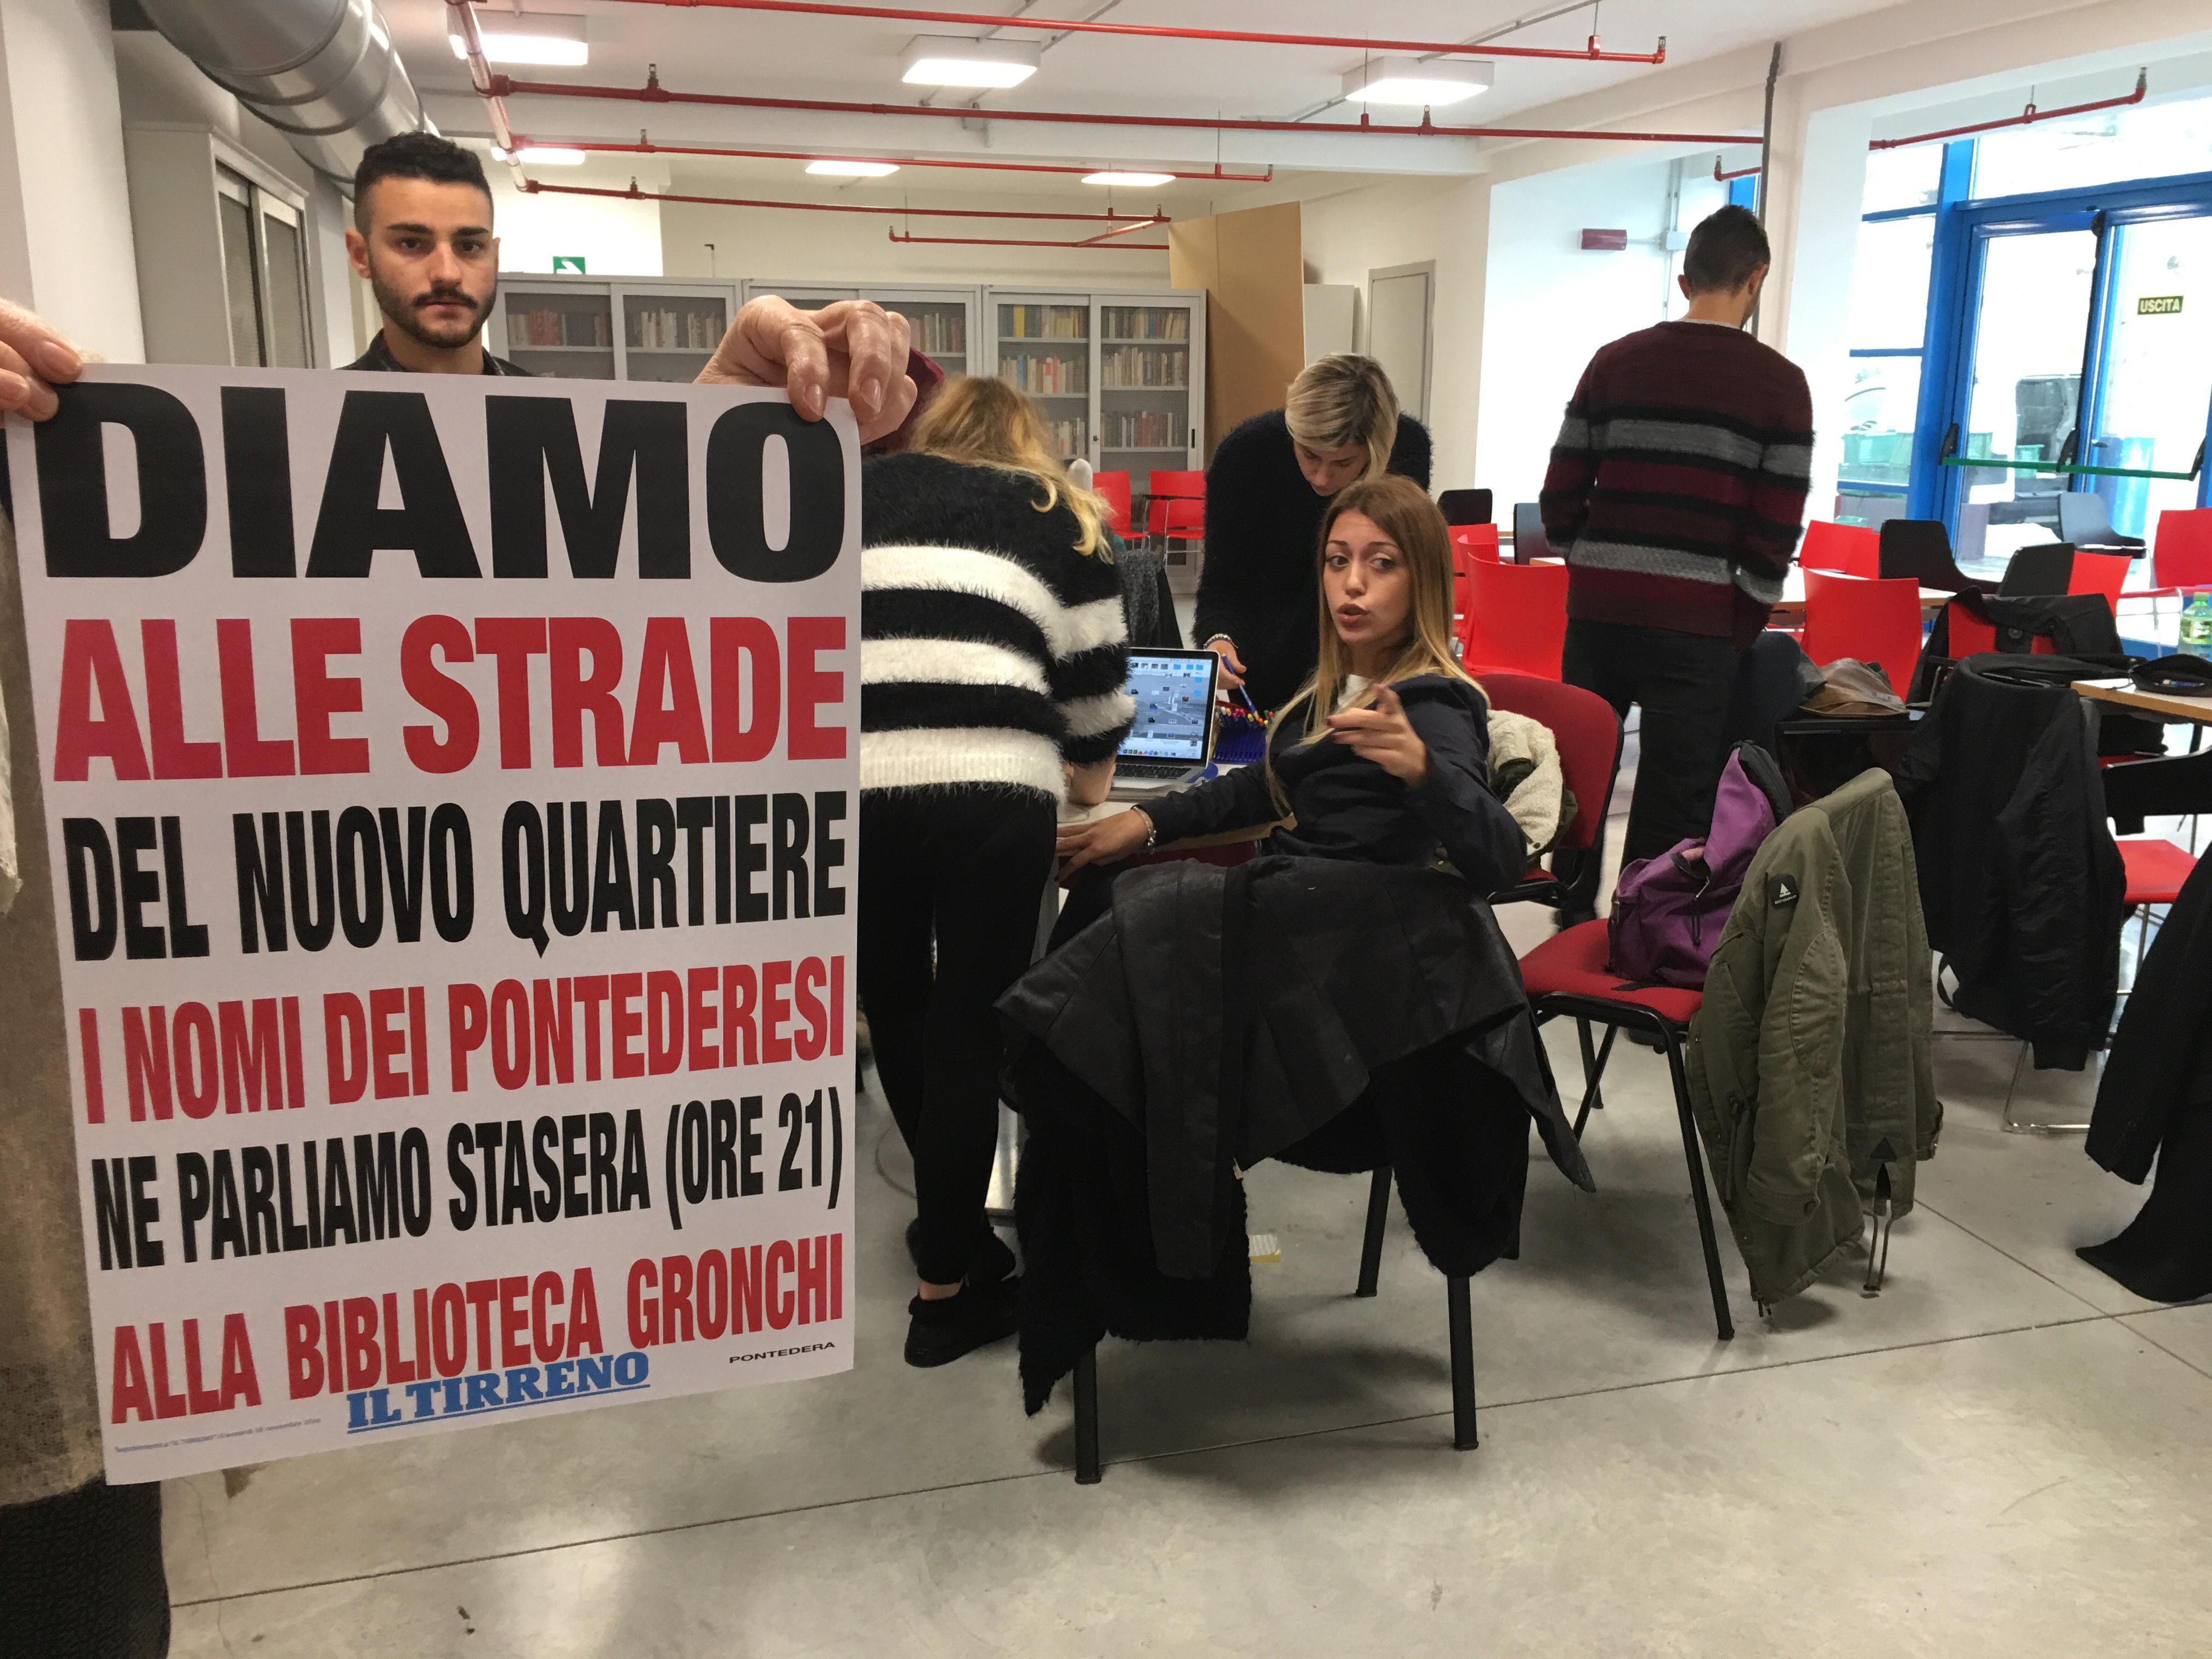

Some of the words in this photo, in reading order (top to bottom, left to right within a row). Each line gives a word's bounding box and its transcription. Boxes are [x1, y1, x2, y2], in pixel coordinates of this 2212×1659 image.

[2140, 298, 2180, 313] USCITA
[33, 381, 845, 583] DIAMO
[54, 618, 370, 782] ALLE
[400, 614, 847, 774] STRADE
[62, 816, 210, 961] DEL
[232, 803, 475, 954] NUOVO
[501, 791, 847, 958] QUARTIERE
[79, 1008, 105, 1124] I
[122, 996, 305, 1122] NOMI
[323, 986, 429, 1104] DEI
[448, 955, 845, 1092] PONTEDERESI
[92, 1155, 165, 1271] NE
[176, 1127, 432, 1263] PARLIAMO
[447, 1109, 651, 1232] STASERA
[665, 1095, 764, 1231] (ORE
[778, 1086, 843, 1210] 21)
[112, 1310, 261, 1424] ALLA
[285, 1267, 603, 1400] BIBLIOTECA
[627, 1233, 843, 1349] GRONCHI
[346, 1388, 402, 1429] IL
[405, 1351, 649, 1418] TIRRENO
[729, 1342, 835, 1363] PONTEDERA
